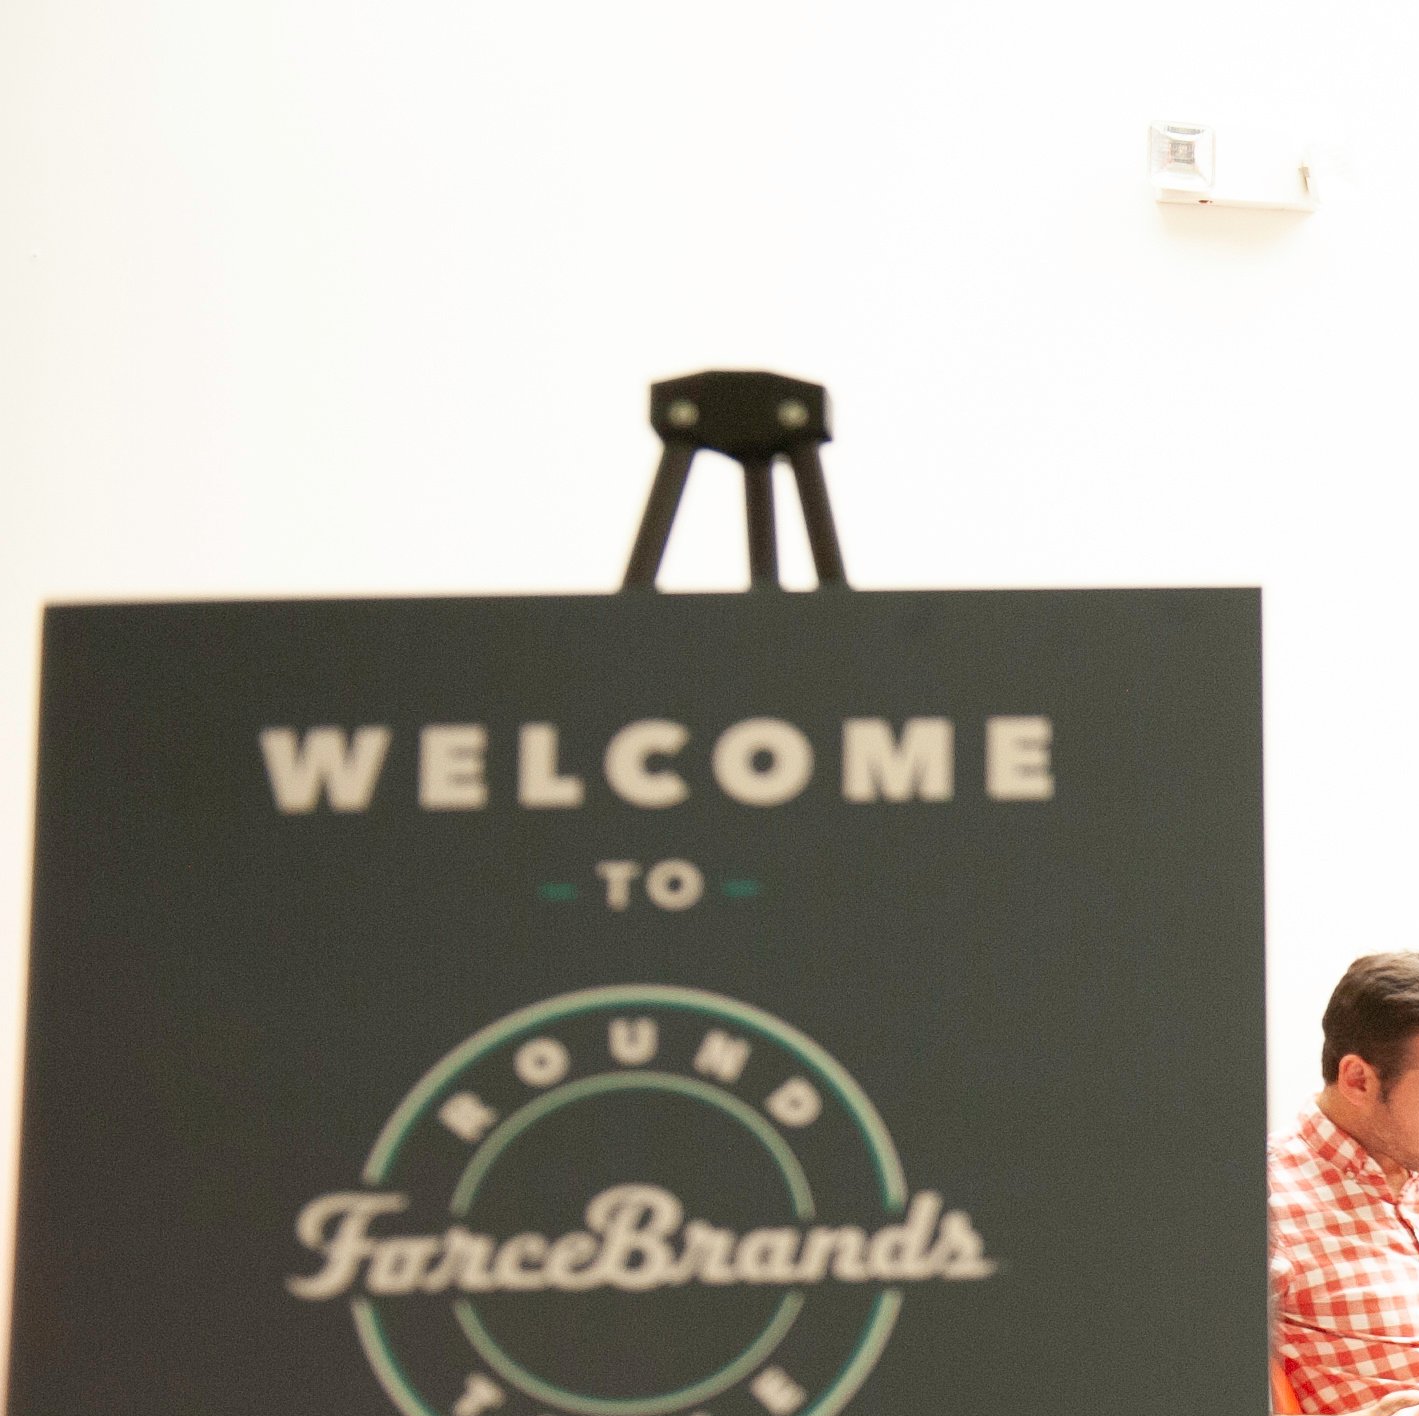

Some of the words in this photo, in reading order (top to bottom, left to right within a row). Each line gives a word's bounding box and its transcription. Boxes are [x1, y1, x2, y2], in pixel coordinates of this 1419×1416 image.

[261, 715, 1055, 813] WELCOME
[597, 858, 704, 911] TO
[439, 1017, 821, 1141] ROUND
[287, 1184, 997, 1300] ForceBrands
